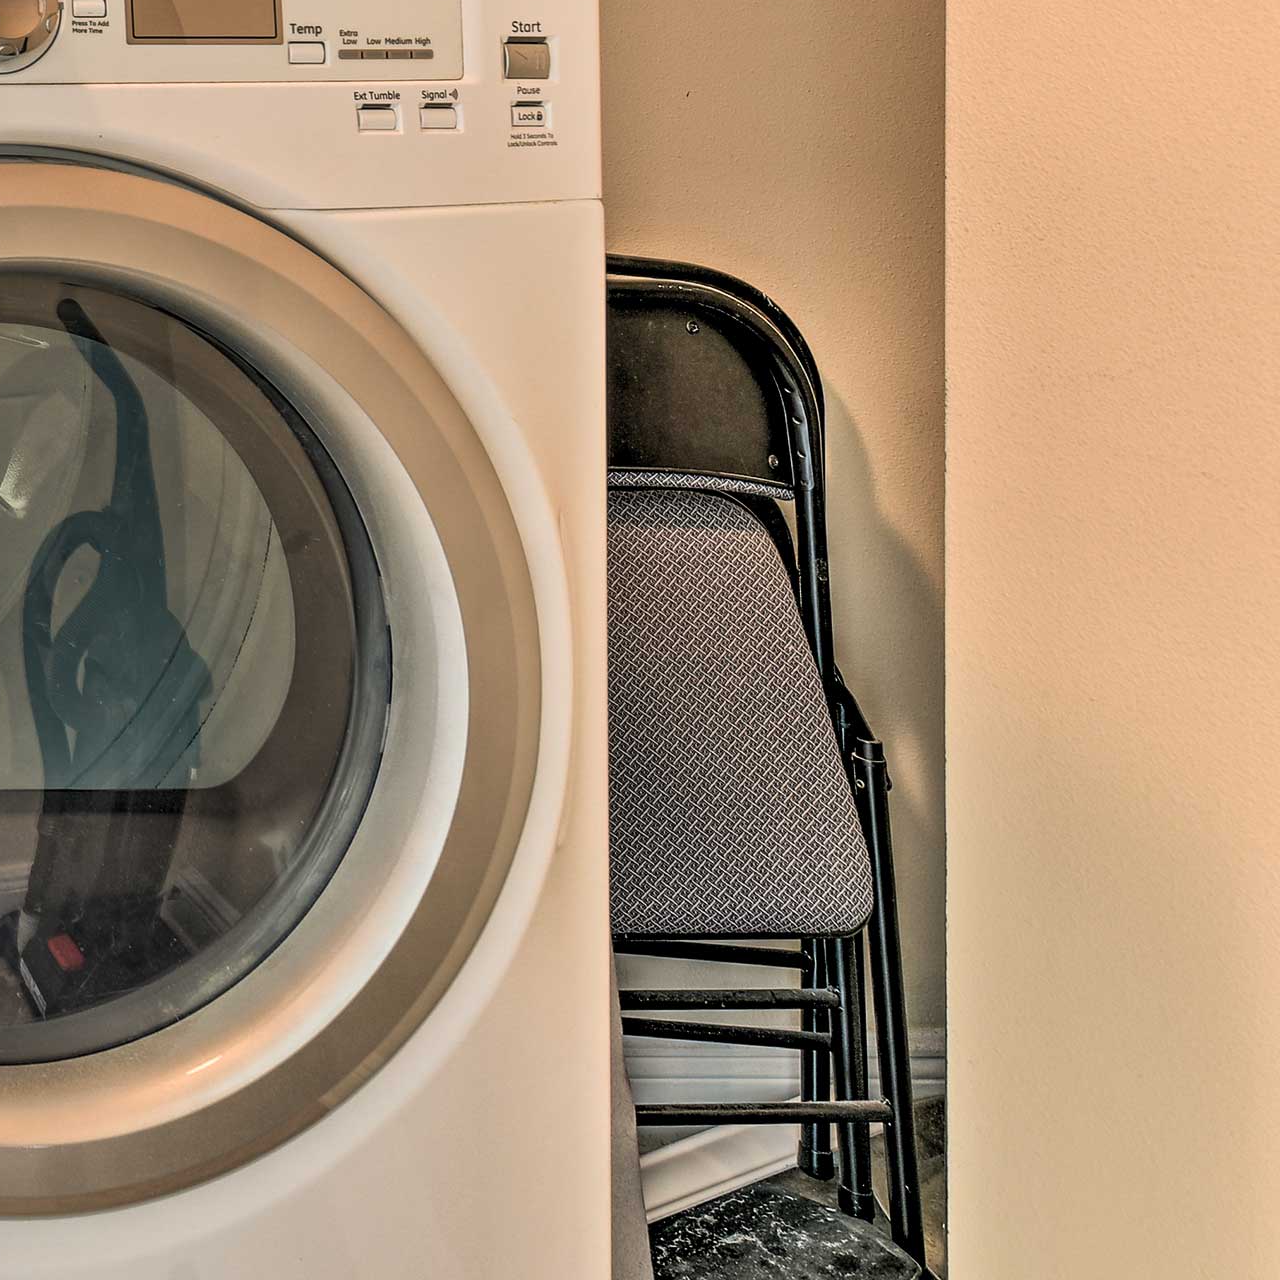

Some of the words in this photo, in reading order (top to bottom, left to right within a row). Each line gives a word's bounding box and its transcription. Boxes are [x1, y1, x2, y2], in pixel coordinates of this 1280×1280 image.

[290, 24, 322, 37] Temp
[511, 20, 542, 33] Start
[339, 29, 358, 37] Extra
[342, 38, 358, 46] Low
[366, 38, 382, 46] Low
[385, 37, 413, 46] Medium
[415, 37, 431, 47] High
[517, 86, 541, 95] Pause
[353, 91, 368, 101] Ext
[369, 90, 401, 101] Tumble
[421, 90, 448, 102] Signal
[518, 112, 536, 121] Lock
